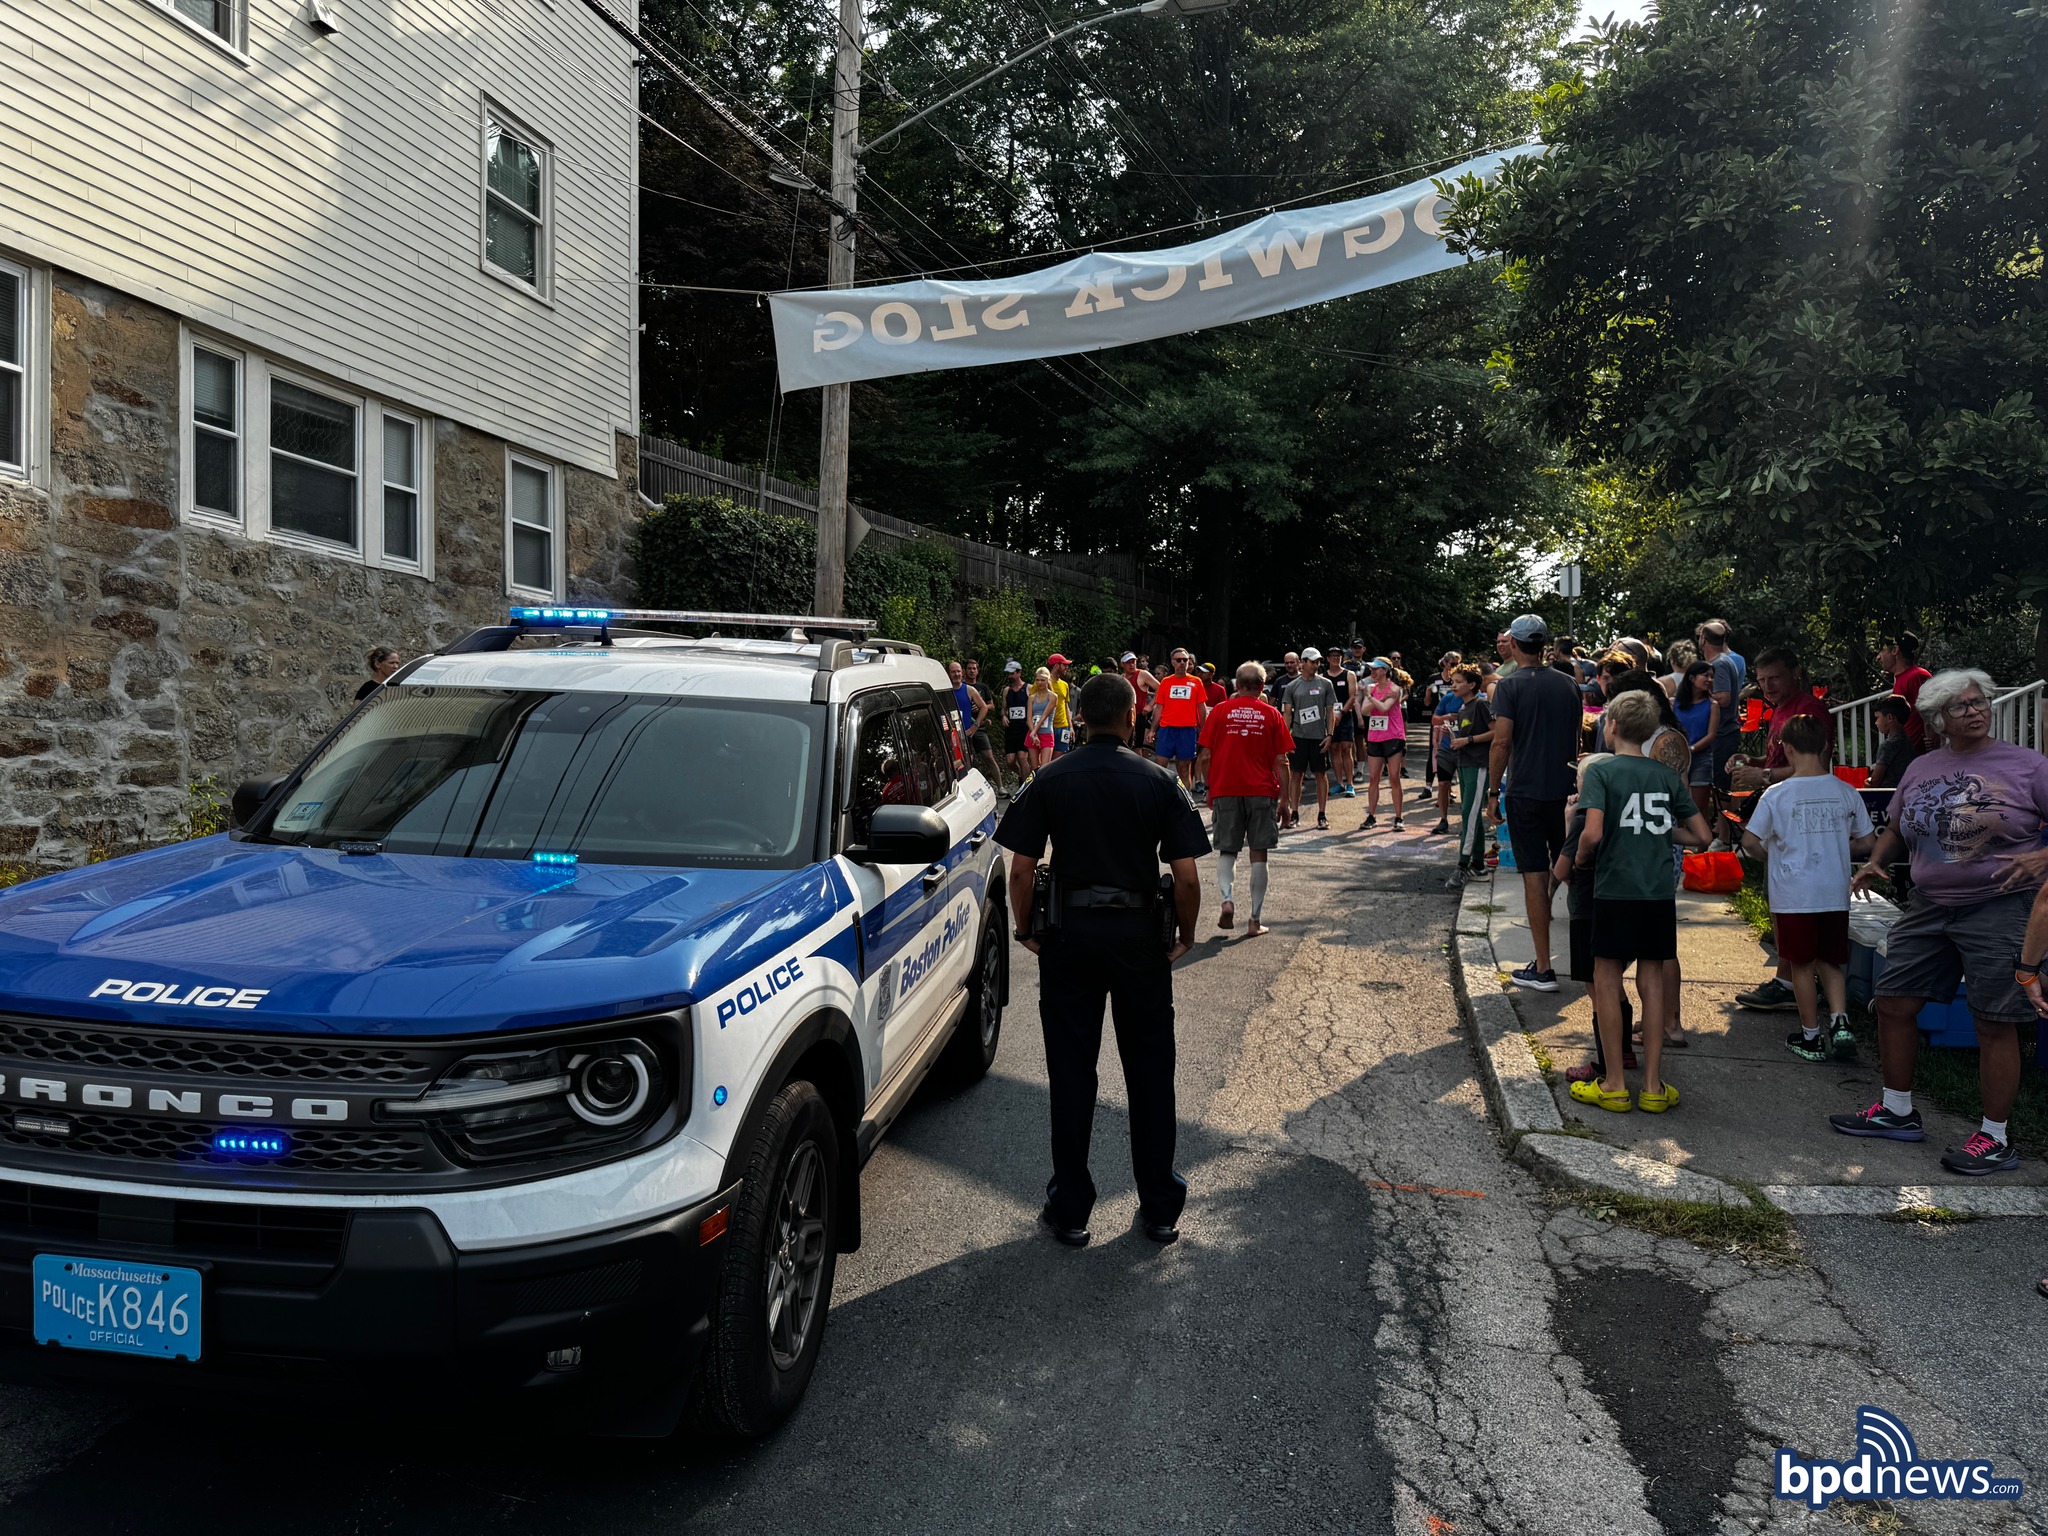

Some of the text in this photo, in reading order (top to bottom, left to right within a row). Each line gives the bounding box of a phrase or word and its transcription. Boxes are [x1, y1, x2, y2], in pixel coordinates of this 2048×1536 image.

[1171, 688, 1187, 697] 4-1
[1010, 709, 1024, 718] 7-2
[1301, 709, 1317, 721] 1-1
[1370, 719, 1384, 728] 3-1
[1620, 792, 1672, 835] 45
[1950, 824, 1988, 841] FESTIVAL
[899, 900, 971, 998] Boston Police
[88, 978, 271, 1010] POLICE
[716, 955, 805, 1030] POLICE
[0, 1074, 348, 1121] RONCO
[71, 1262, 163, 1285] Massachusetts
[42, 1279, 190, 1336] POLICE K846
[89, 1330, 144, 1346] OFFICIAL
